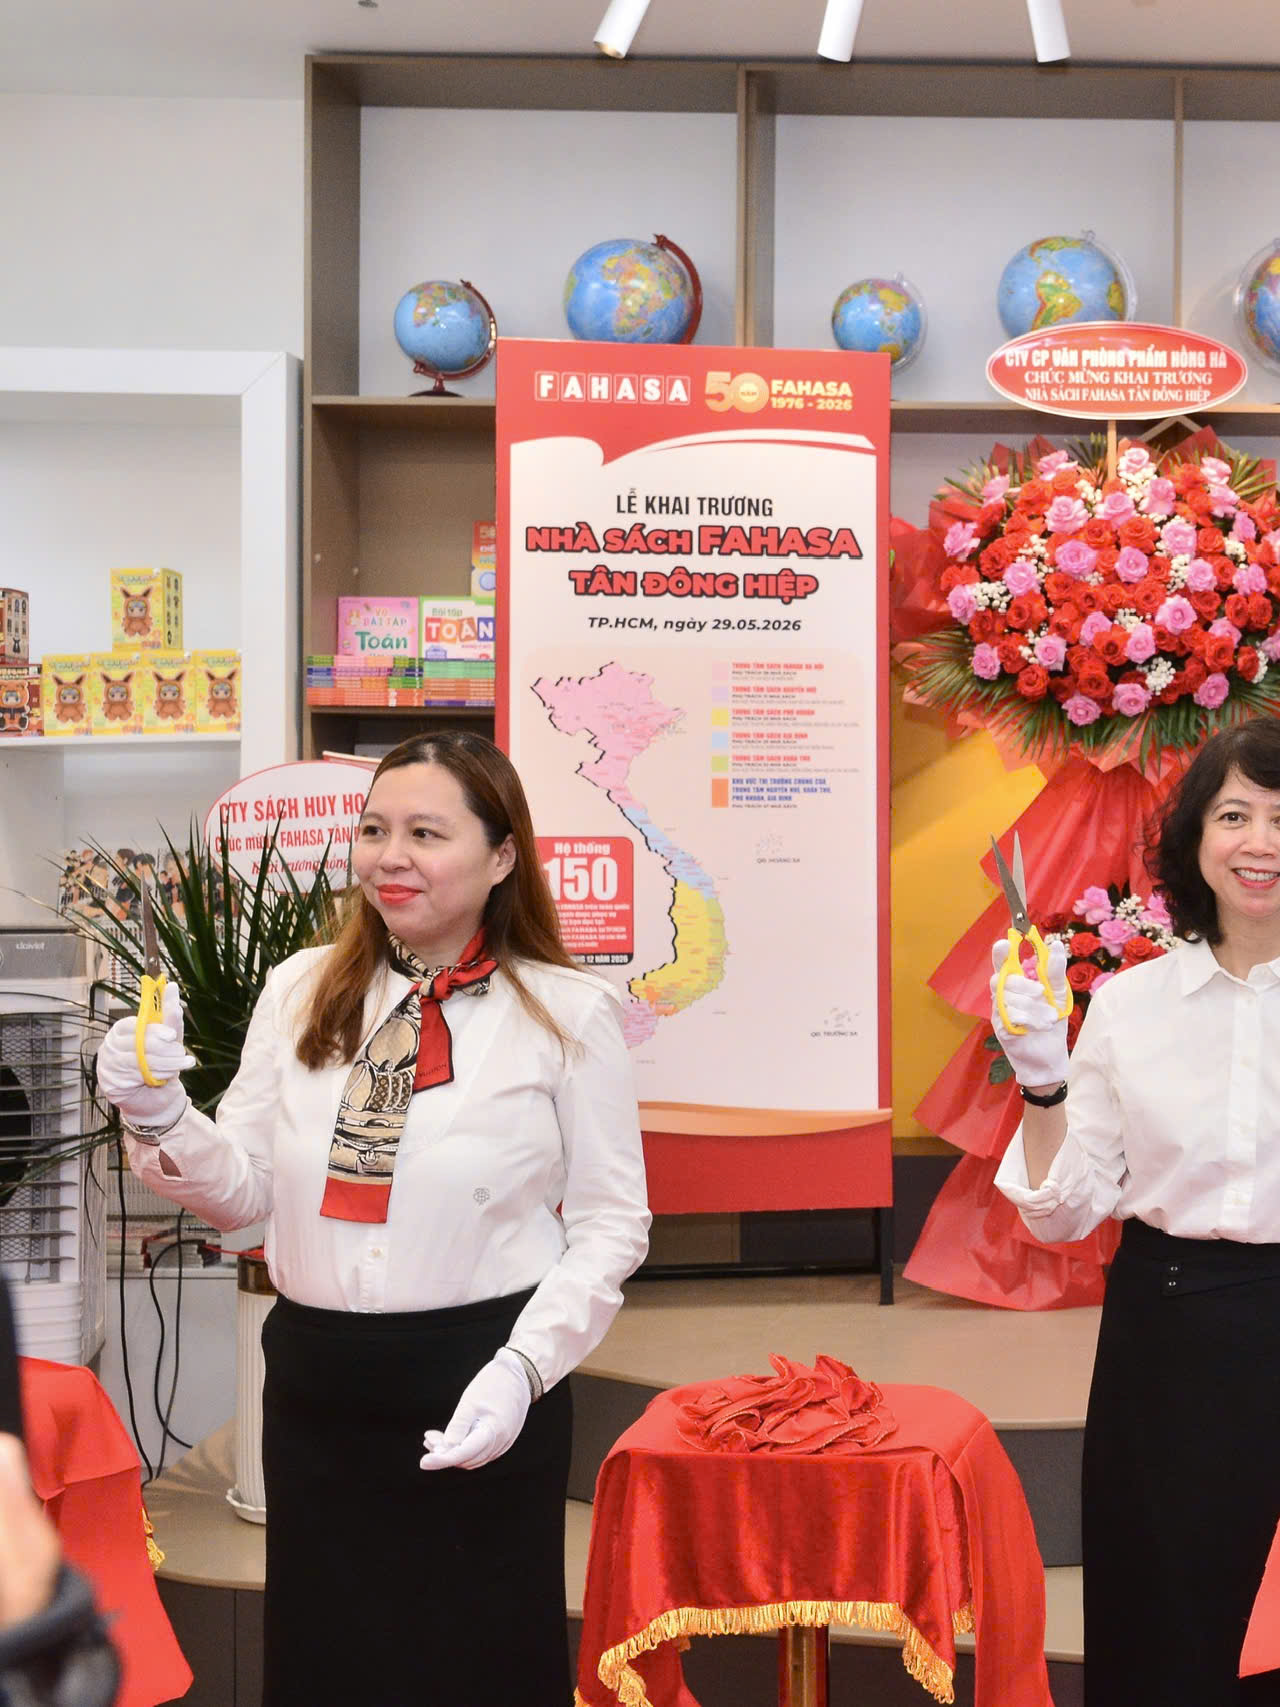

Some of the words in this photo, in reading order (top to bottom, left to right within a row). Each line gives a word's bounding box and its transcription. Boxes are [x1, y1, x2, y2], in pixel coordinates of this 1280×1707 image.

[1005, 349, 1028, 368] CTY
[1032, 350, 1050, 368] CP
[1053, 347, 1078, 368] VĂN
[1082, 346, 1125, 368] PHÒNG
[1209, 347, 1227, 369] HÀ
[539, 374, 689, 403] FAHASA
[771, 379, 852, 397] FAHASA
[1024, 368, 1065, 385] CHÚC
[1068, 368, 1110, 385] MỪNG
[1114, 371, 1149, 385] KHAI
[1151, 370, 1212, 386] TRƯƠNG
[705, 371, 769, 413] 50
[771, 397, 803, 410] 1976
[817, 398, 852, 411] 2026
[1025, 386, 1048, 402] NHÀ
[1050, 386, 1080, 402] SÁCH
[1082, 389, 1126, 402] FAHASA
[1128, 387, 1150, 402] TÂN
[616, 488, 637, 513] LỄ
[645, 495, 689, 514] KHAI
[697, 496, 773, 517] TRƯƠNG
[526, 522, 600, 553] NHÀ
[603, 523, 692, 555] SÁCH
[699, 525, 863, 559] FAHASA
[569, 565, 636, 596] TÂN
[641, 567, 737, 598] ĐÔNG
[744, 569, 818, 605] HIỆP
[588, 616, 657, 631] TP.HCM,
[663, 618, 707, 632] ngày
[712, 618, 801, 632] 29.05.2026
[355, 632, 407, 650] Toán
[220, 802, 247, 824] CTY
[254, 795, 298, 822] SÁCH
[304, 795, 336, 818] HUY
[215, 834, 242, 853] Cúc
[280, 828, 324, 848] FAHASA
[554, 843, 571, 857] Hệ
[574, 841, 611, 855] thống
[543, 857, 618, 901] 150
